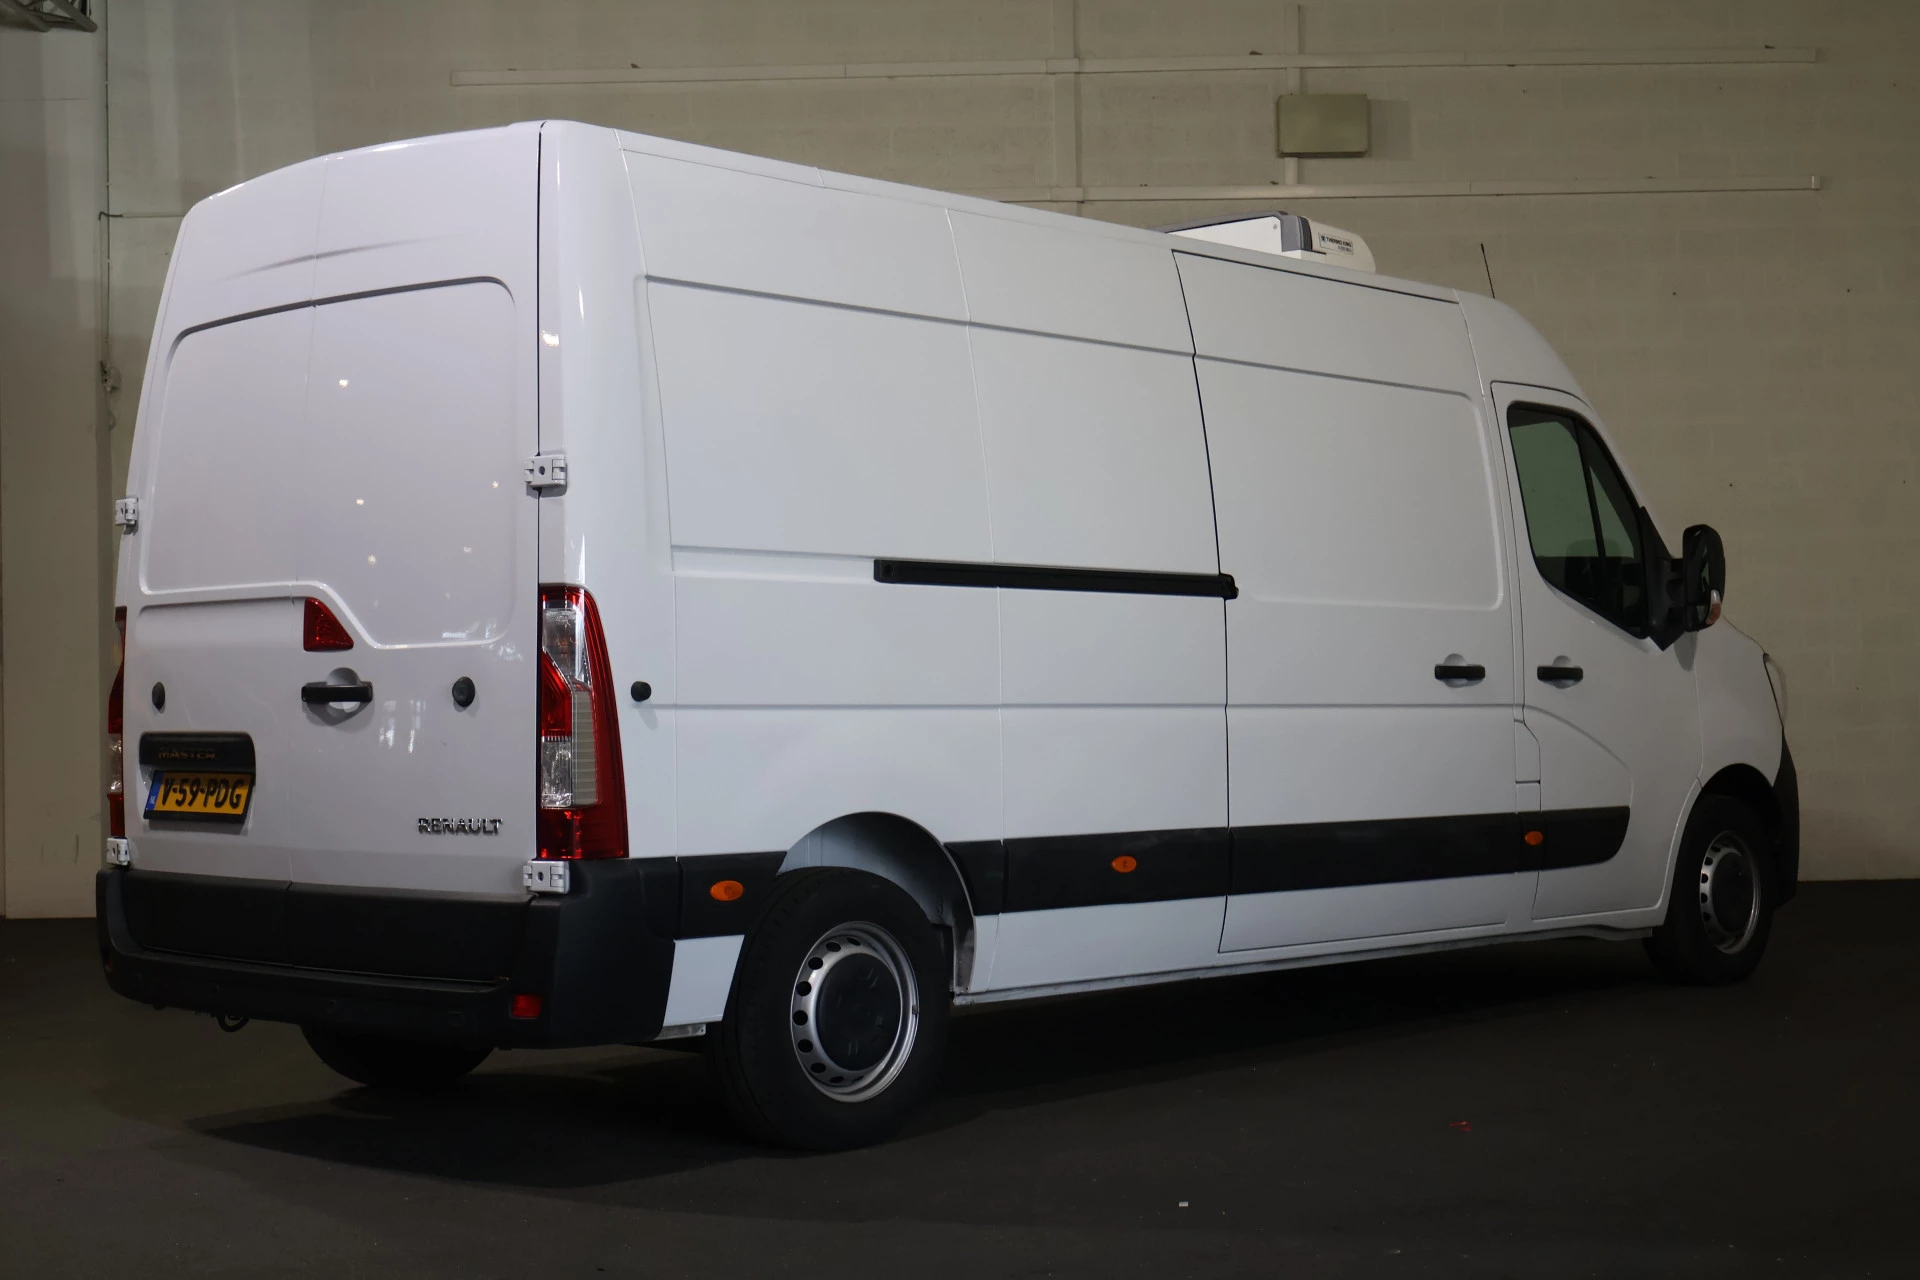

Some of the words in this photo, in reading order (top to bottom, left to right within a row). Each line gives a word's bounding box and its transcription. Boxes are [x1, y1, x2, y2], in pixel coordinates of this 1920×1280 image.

[158, 748, 217, 760] MASTER
[161, 777, 245, 809] V-59-PDG
[418, 818, 503, 834] RENAULT
